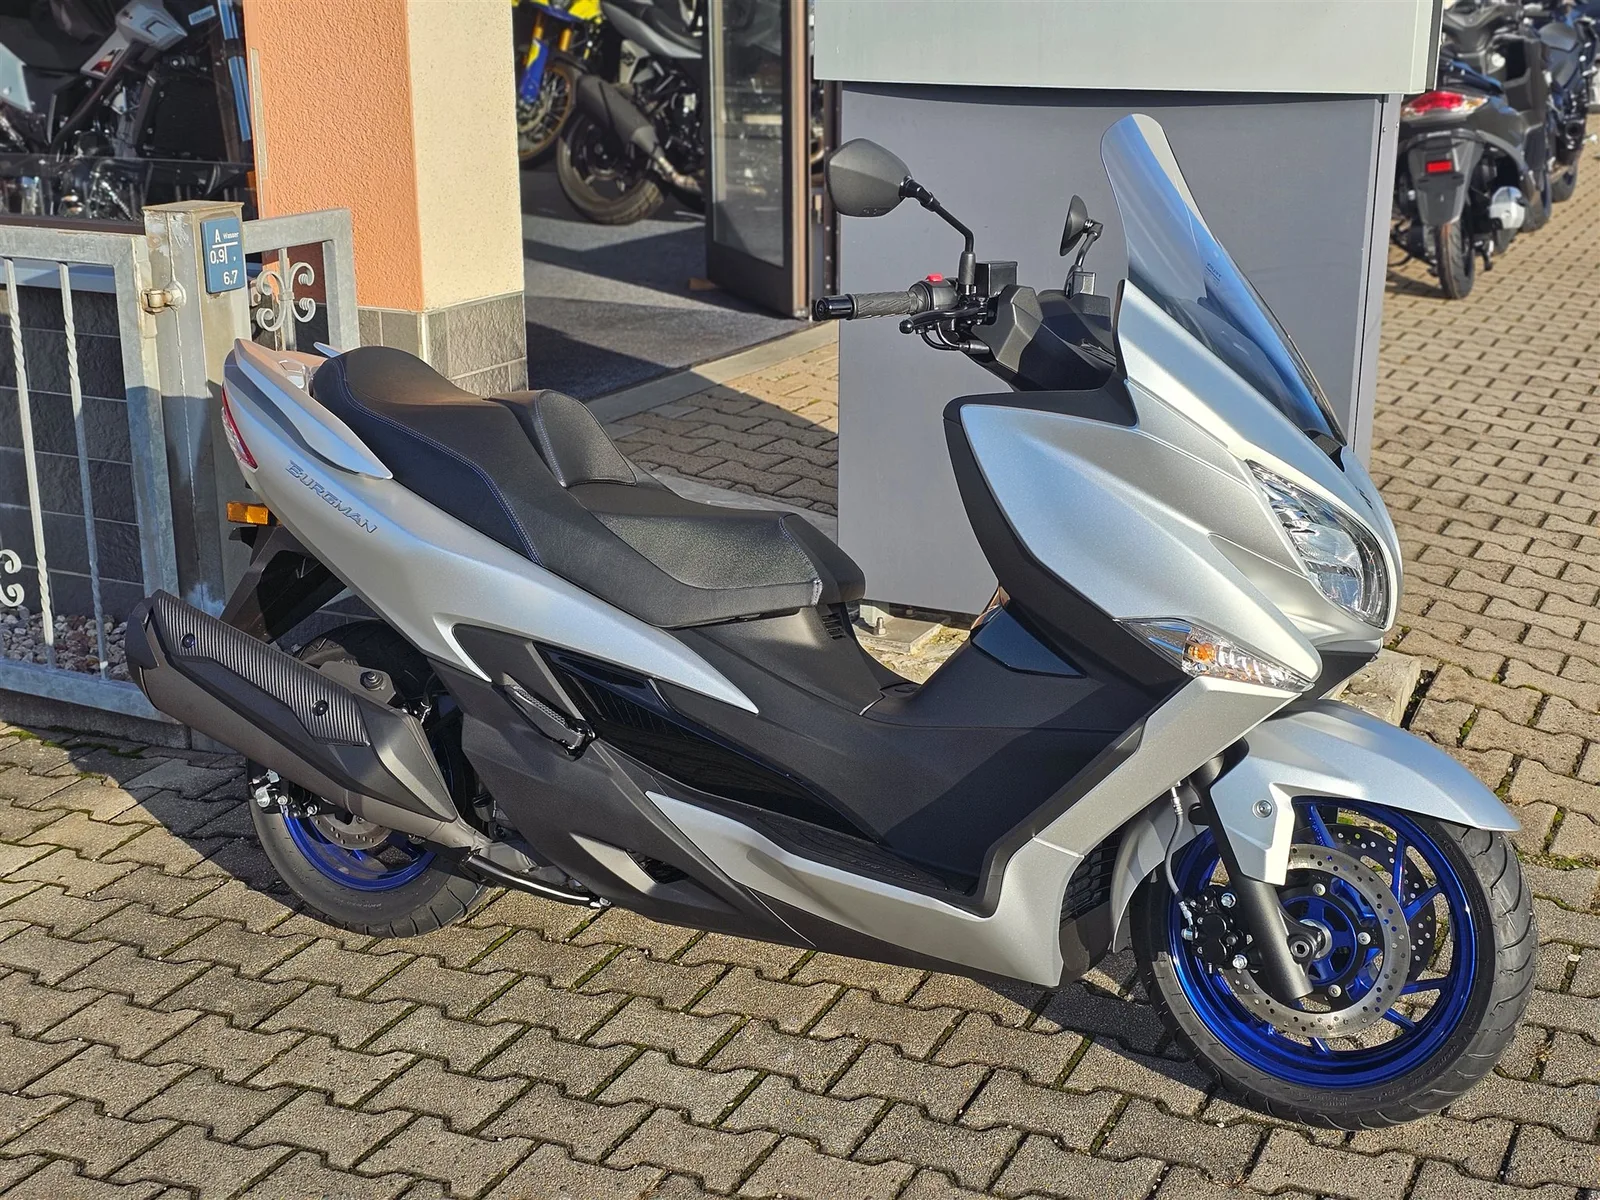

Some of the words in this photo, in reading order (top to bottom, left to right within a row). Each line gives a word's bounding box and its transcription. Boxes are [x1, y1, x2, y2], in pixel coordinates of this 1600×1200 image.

[215, 229, 221, 243] A
[210, 249, 225, 264] 0,9
[223, 270, 238, 285] 6,7
[285, 460, 378, 534] BURGMAN
